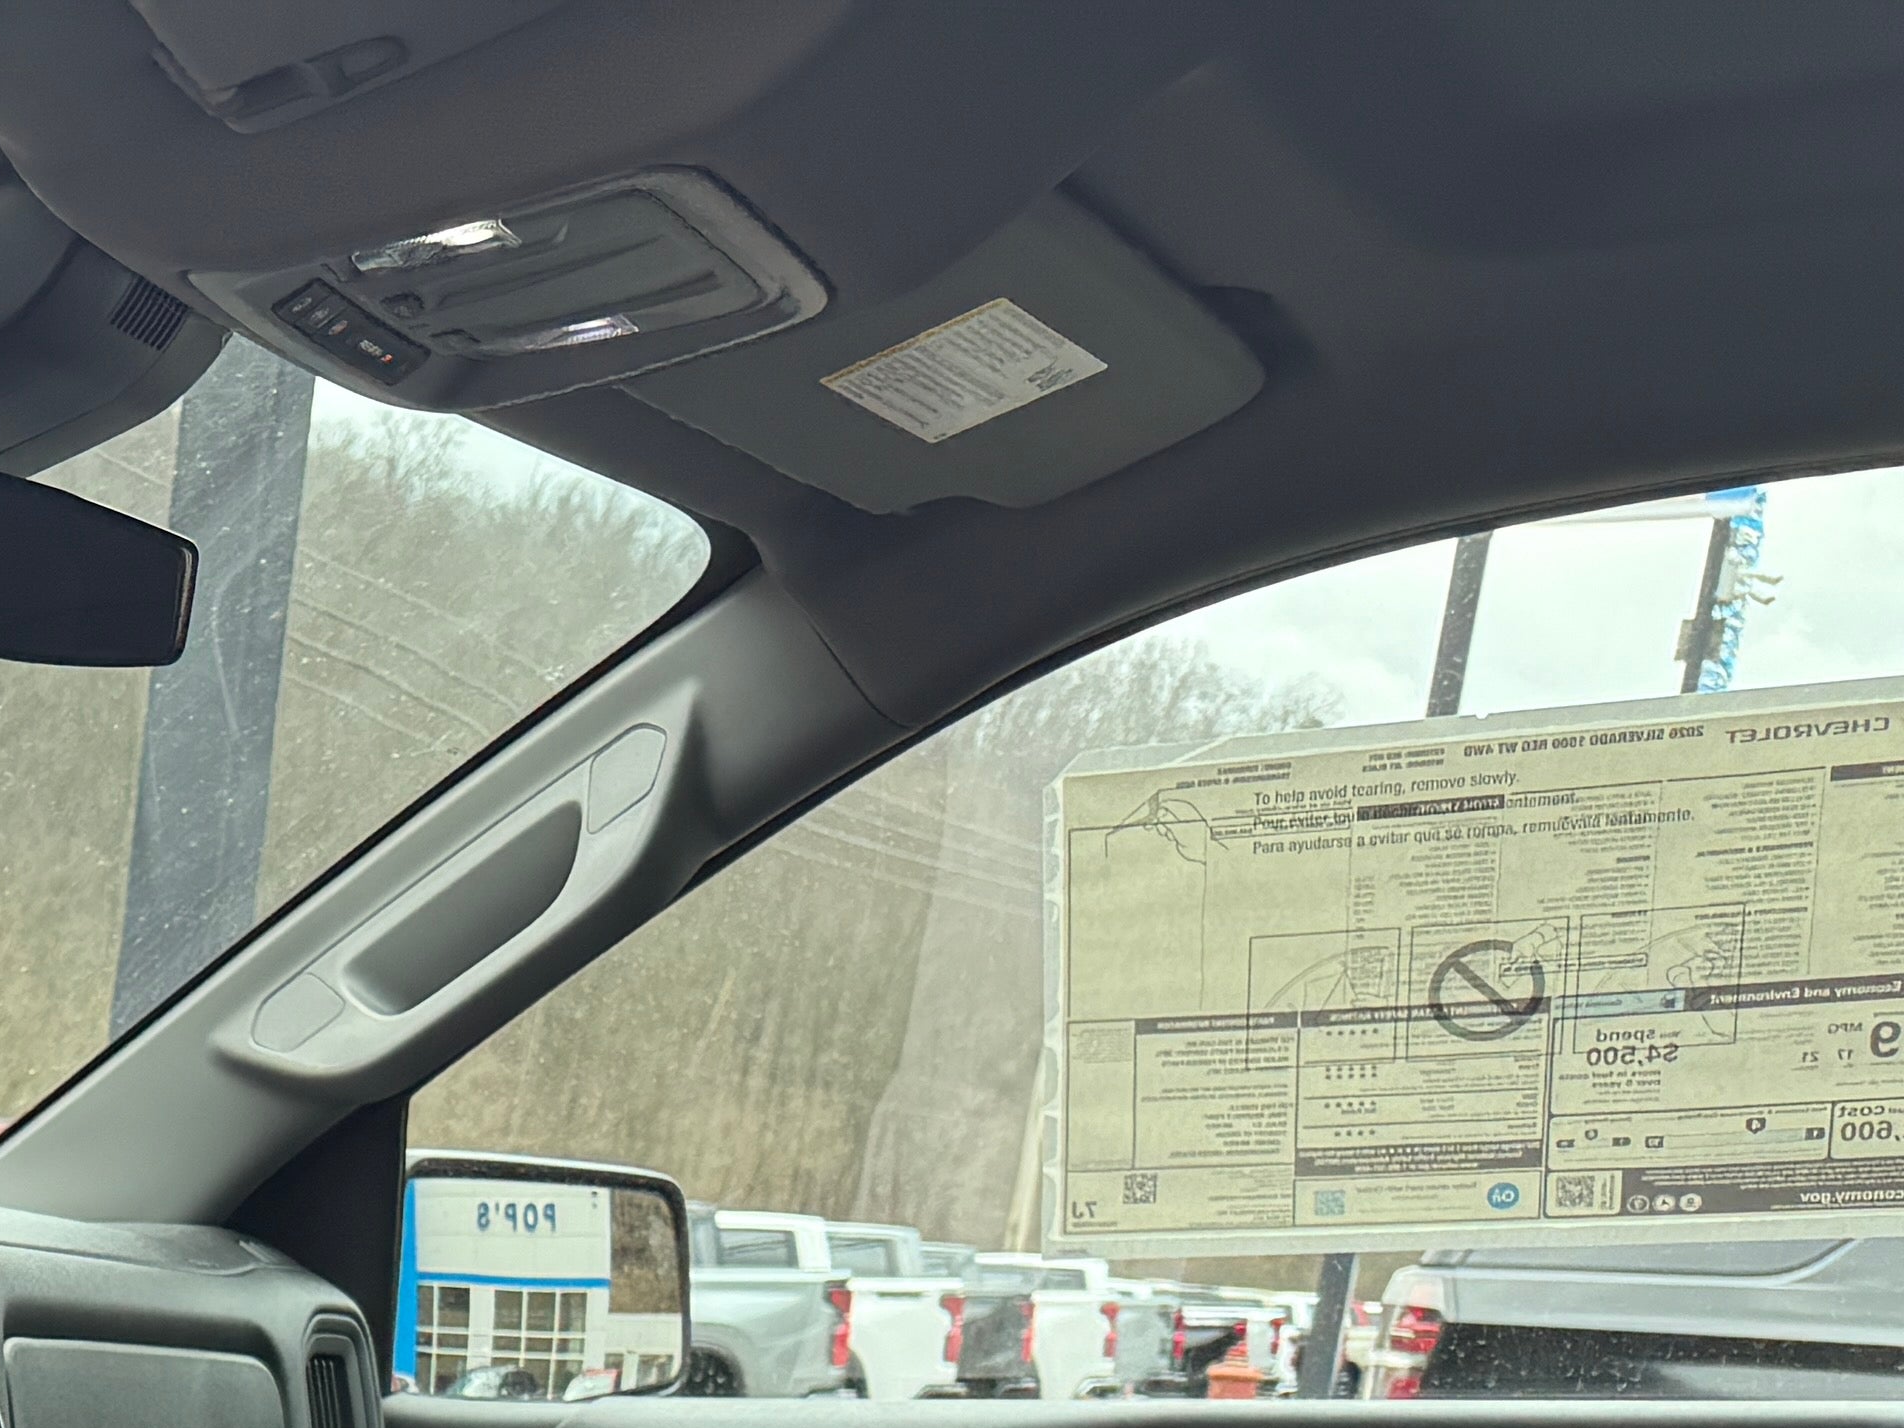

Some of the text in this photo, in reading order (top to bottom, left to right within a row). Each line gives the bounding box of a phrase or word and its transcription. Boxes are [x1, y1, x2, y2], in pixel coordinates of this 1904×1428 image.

[1254, 769, 1520, 806] To help avoid tearing, remove slowly.
[1253, 839, 1285, 855] Para
[1288, 835, 1352, 855] ayudarse
[1356, 834, 1366, 848] a
[1369, 829, 1411, 847] evitar
